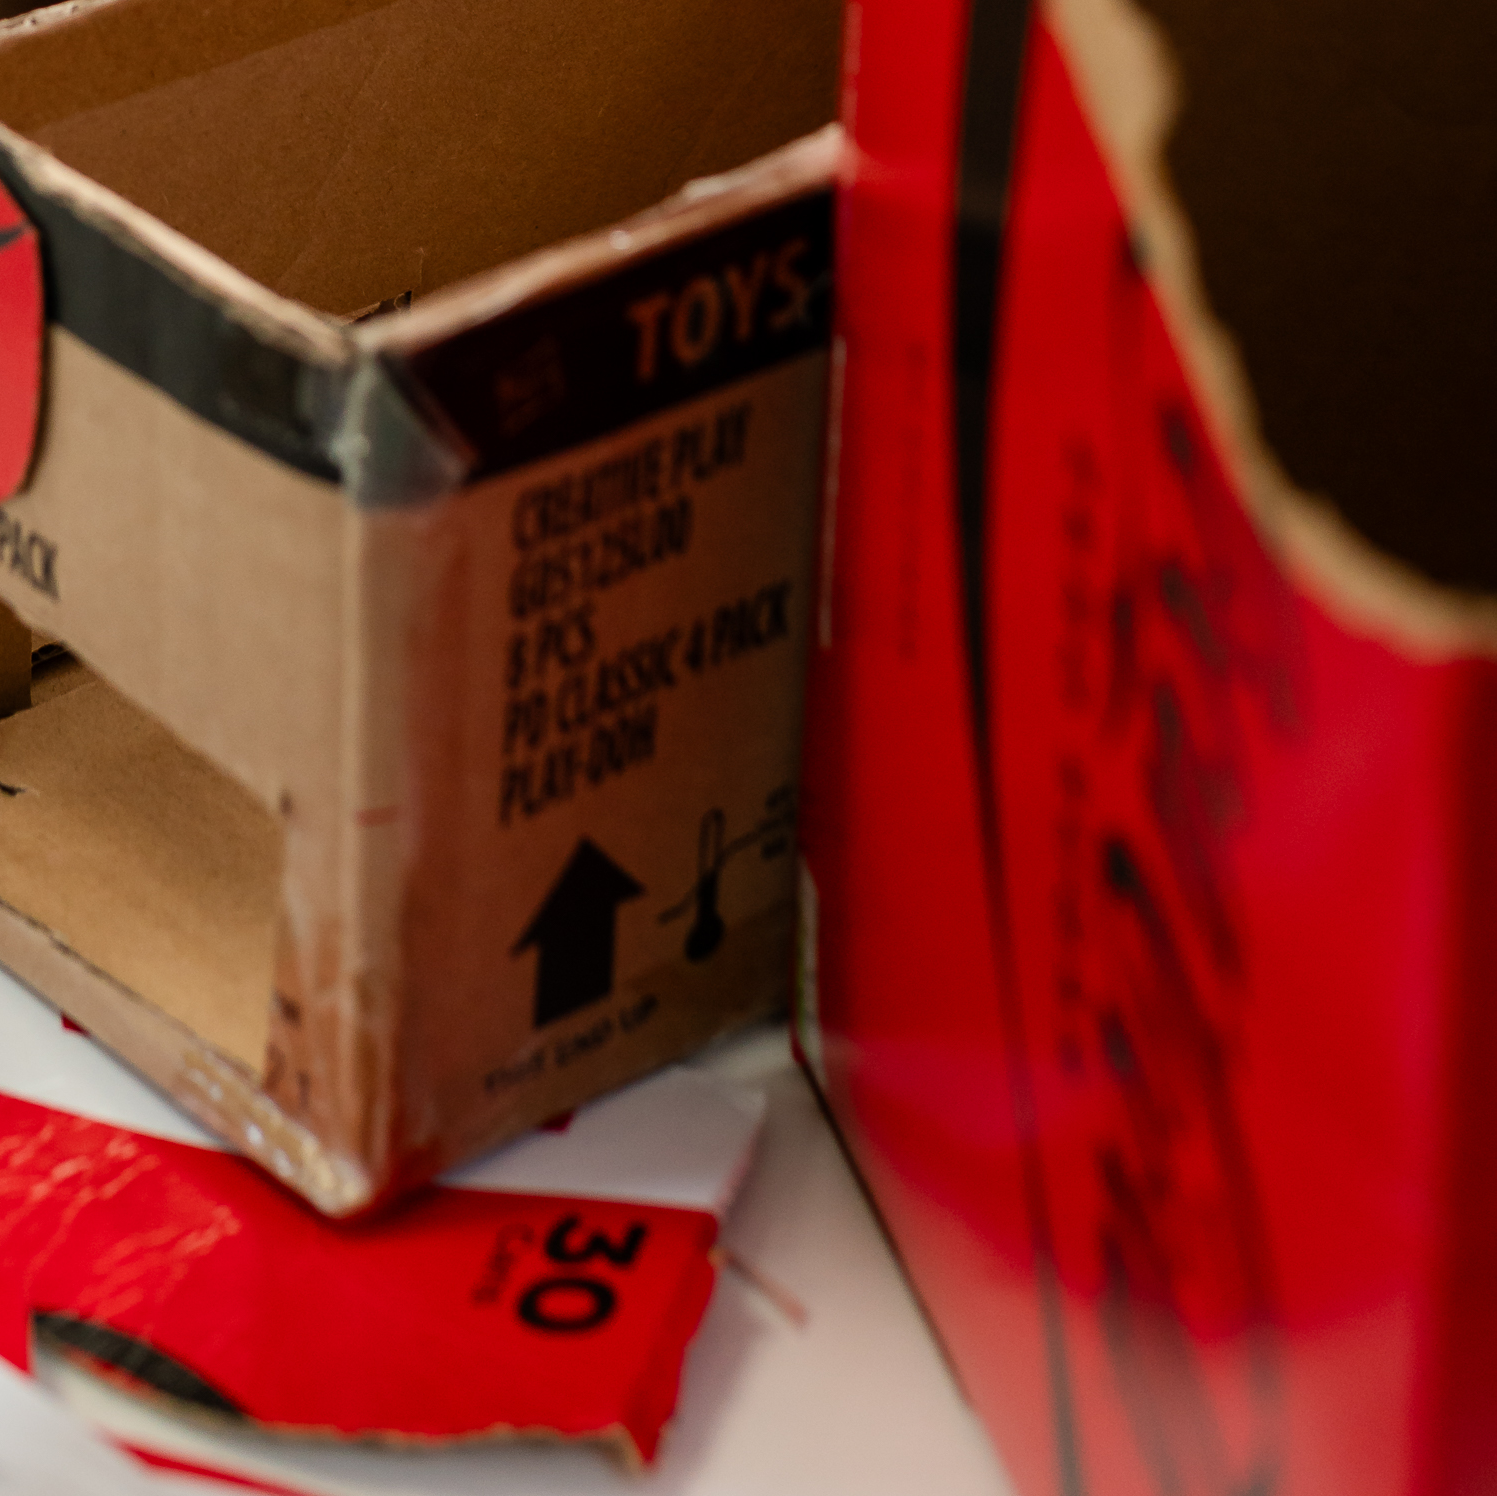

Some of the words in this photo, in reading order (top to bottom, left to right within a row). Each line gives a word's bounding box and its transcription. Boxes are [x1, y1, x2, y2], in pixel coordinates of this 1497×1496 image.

[623, 236, 813, 385] TOYS
[511, 438, 661, 552] CREATIVE
[669, 403, 753, 489] PLAY
[556, 627, 681, 735] CLASSIC
[710, 580, 793, 668] PACK
[500, 705, 658, 827] PLAY-DOH
[516, 1211, 650, 1334] 30
